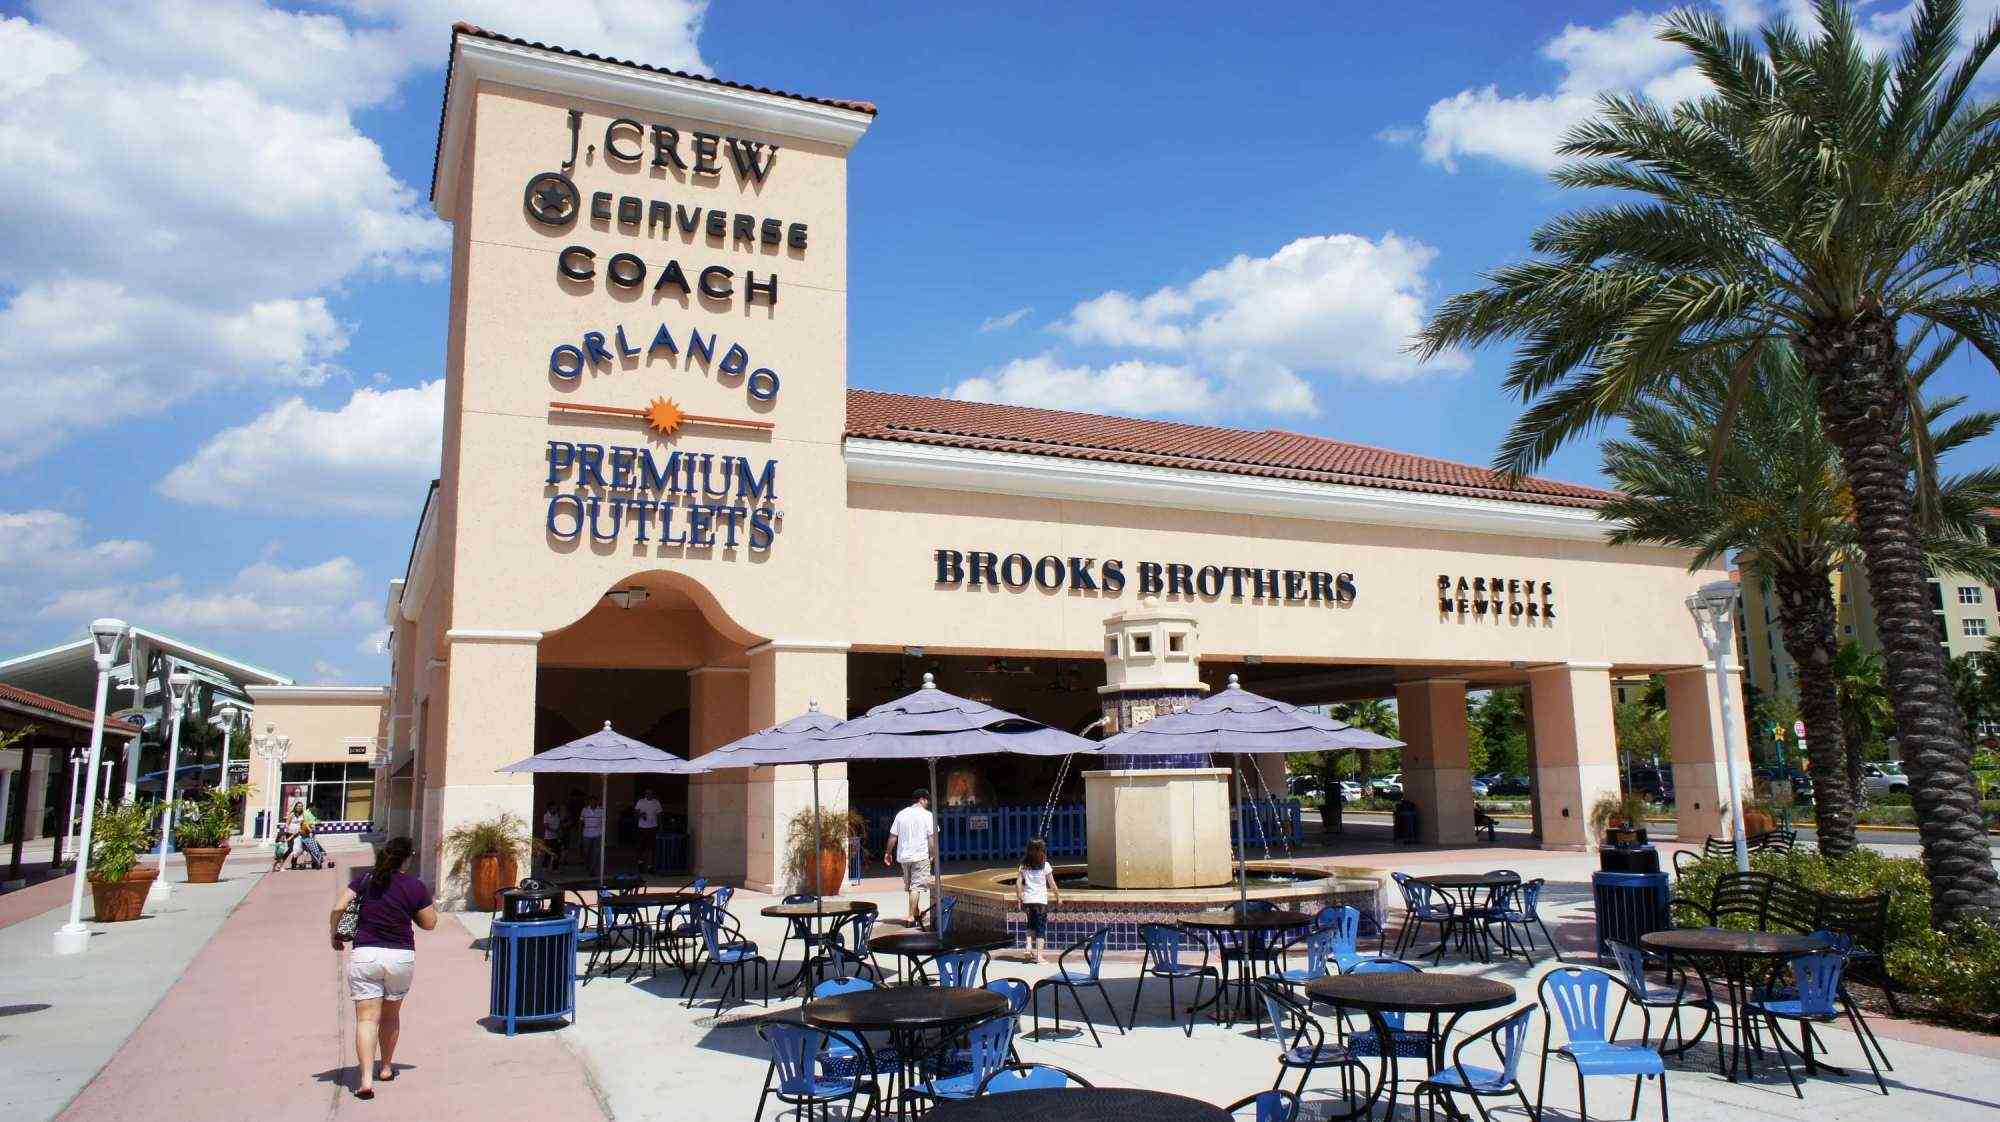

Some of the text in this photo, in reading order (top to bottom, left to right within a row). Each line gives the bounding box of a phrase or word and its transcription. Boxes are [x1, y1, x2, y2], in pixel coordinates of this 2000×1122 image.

[562, 109, 780, 183] J.CREW
[592, 191, 809, 250] CONVERSE
[558, 246, 778, 305] COACH
[550, 322, 780, 400] ORLANDO
[546, 440, 779, 500] PREMIUM
[935, 549, 1357, 602] BROOKS BROTHERS
[1439, 574, 1553, 595] BARNEYS
